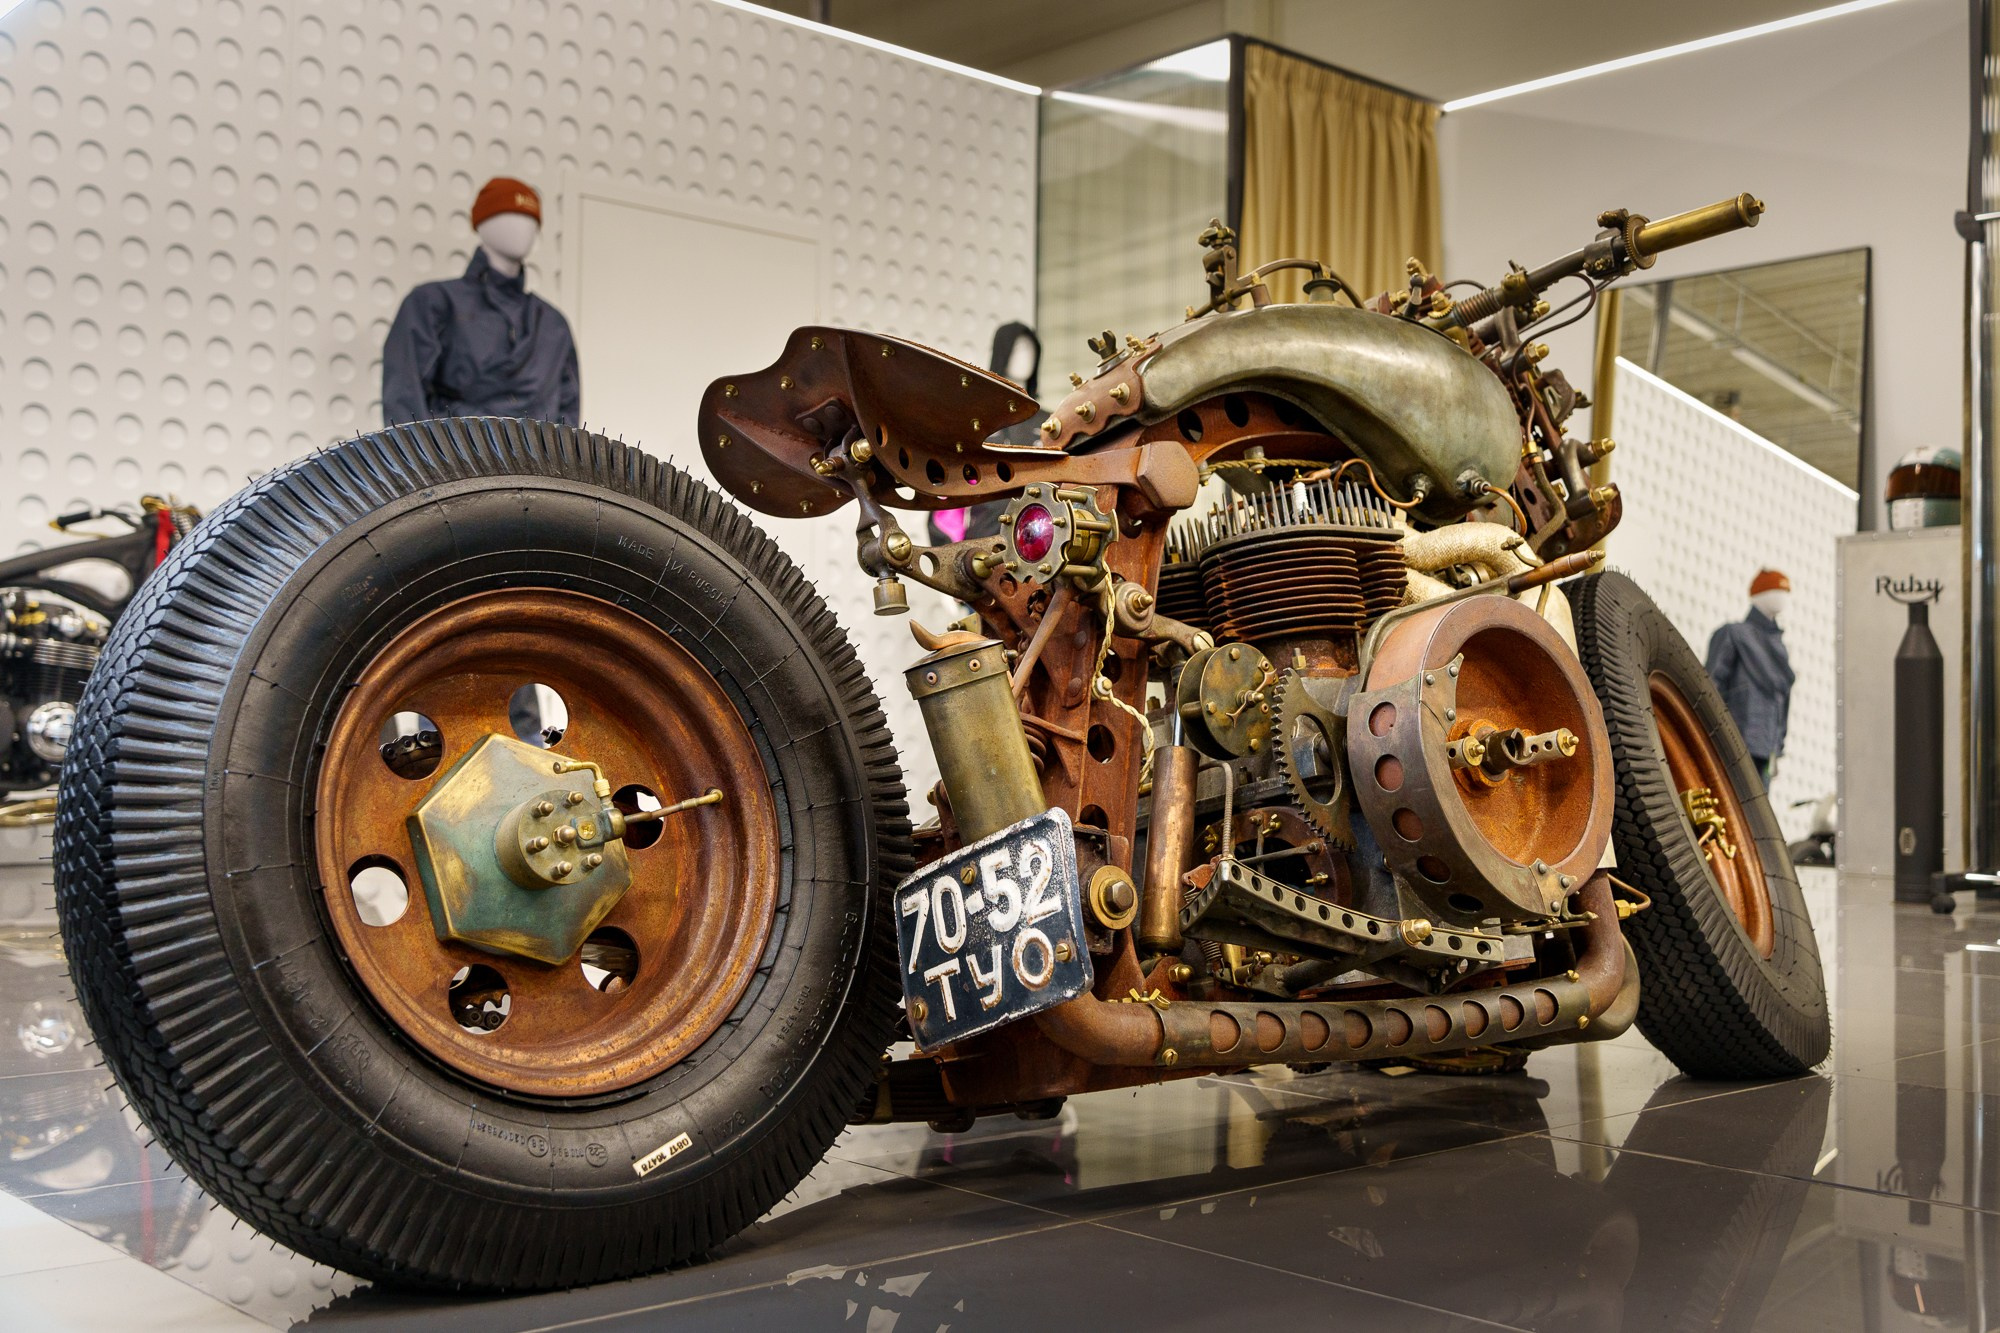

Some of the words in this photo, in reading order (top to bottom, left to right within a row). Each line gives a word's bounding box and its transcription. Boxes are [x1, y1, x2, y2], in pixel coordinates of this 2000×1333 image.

[686, 571, 731, 607] RUSSIA
[1875, 573, 1944, 604] Ruby
[902, 838, 1062, 975] 70-52
[667, 1137, 690, 1155] 0817
